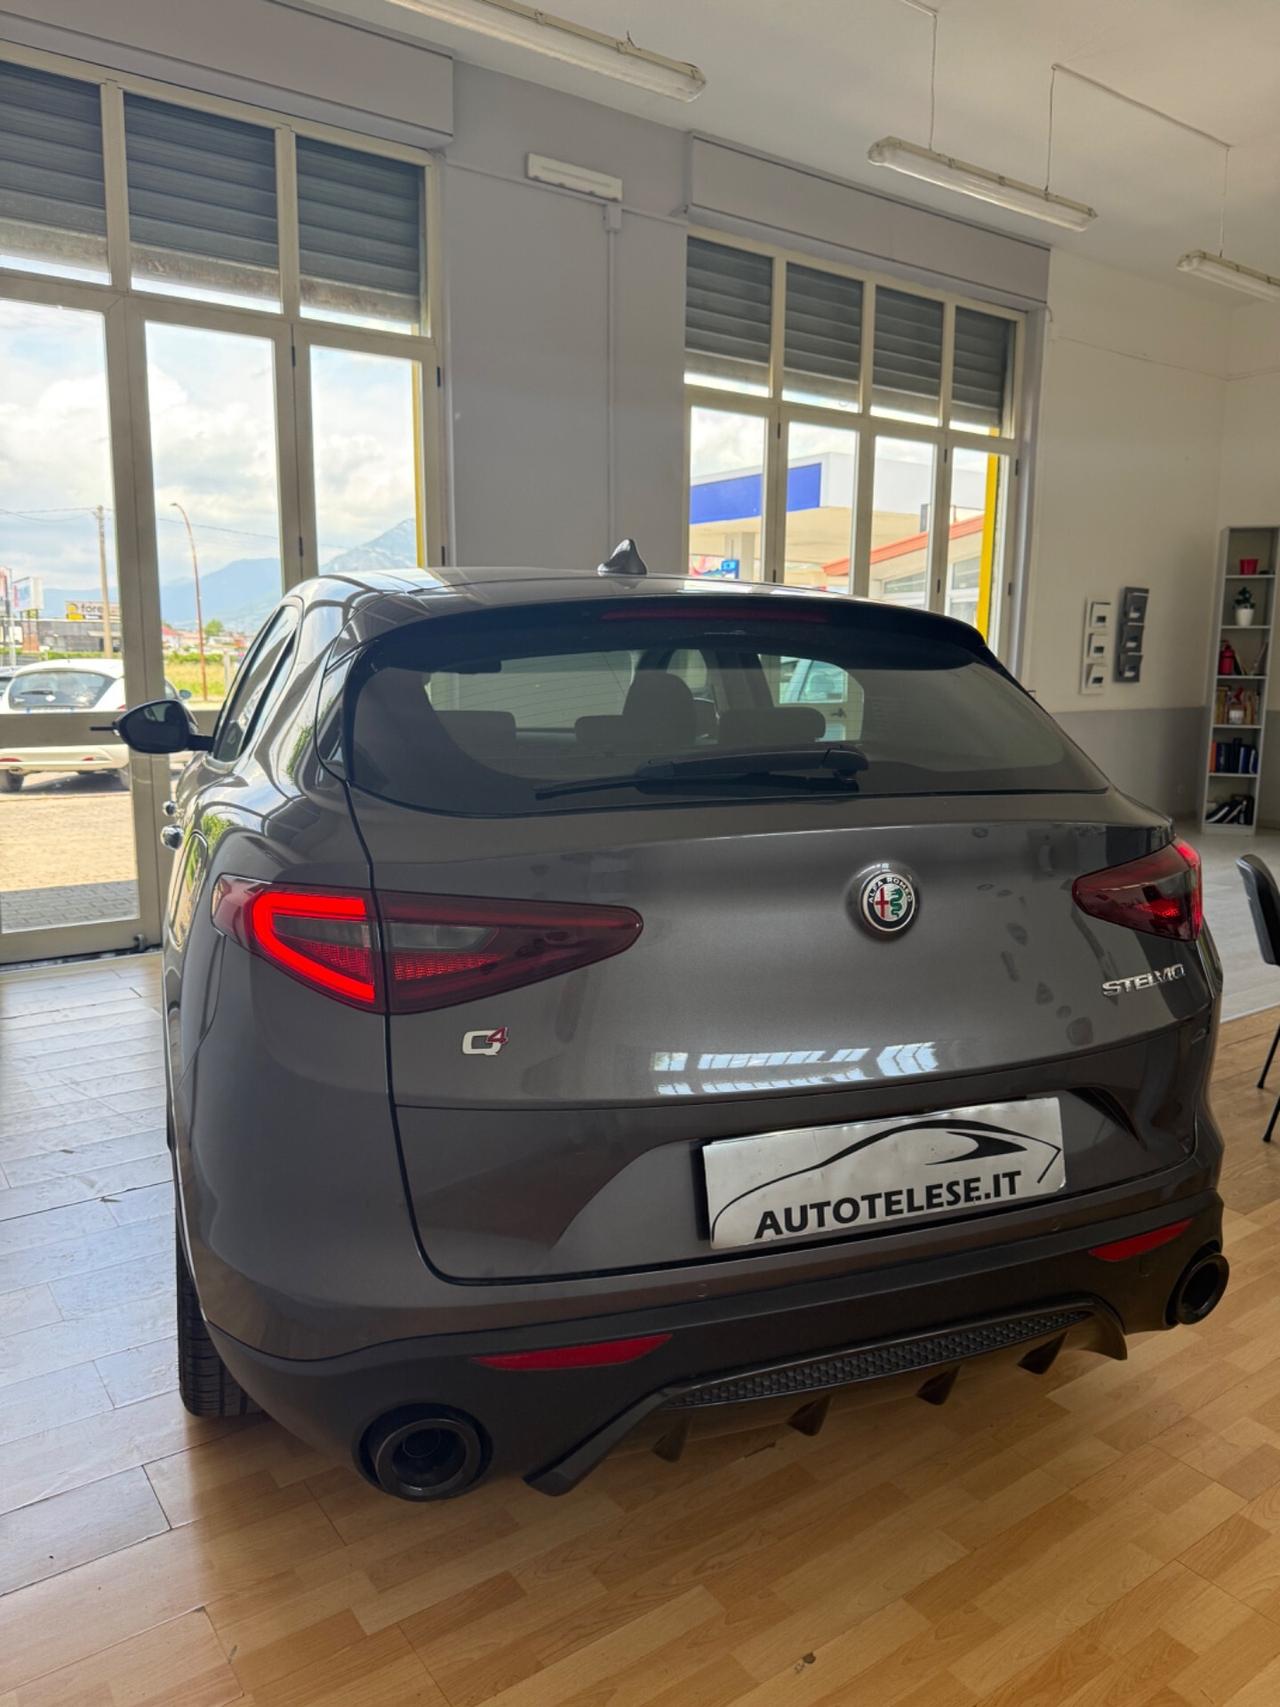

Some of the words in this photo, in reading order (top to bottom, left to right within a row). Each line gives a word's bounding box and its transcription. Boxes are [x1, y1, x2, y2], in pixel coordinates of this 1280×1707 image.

[868, 881, 883, 903] ALFA
[886, 877, 913, 902] ROMEO
[1102, 963, 1185, 996] STELVIO
[462, 1026, 508, 1055] Q4
[754, 1170, 1022, 1240] AUTOTELESE.IT
